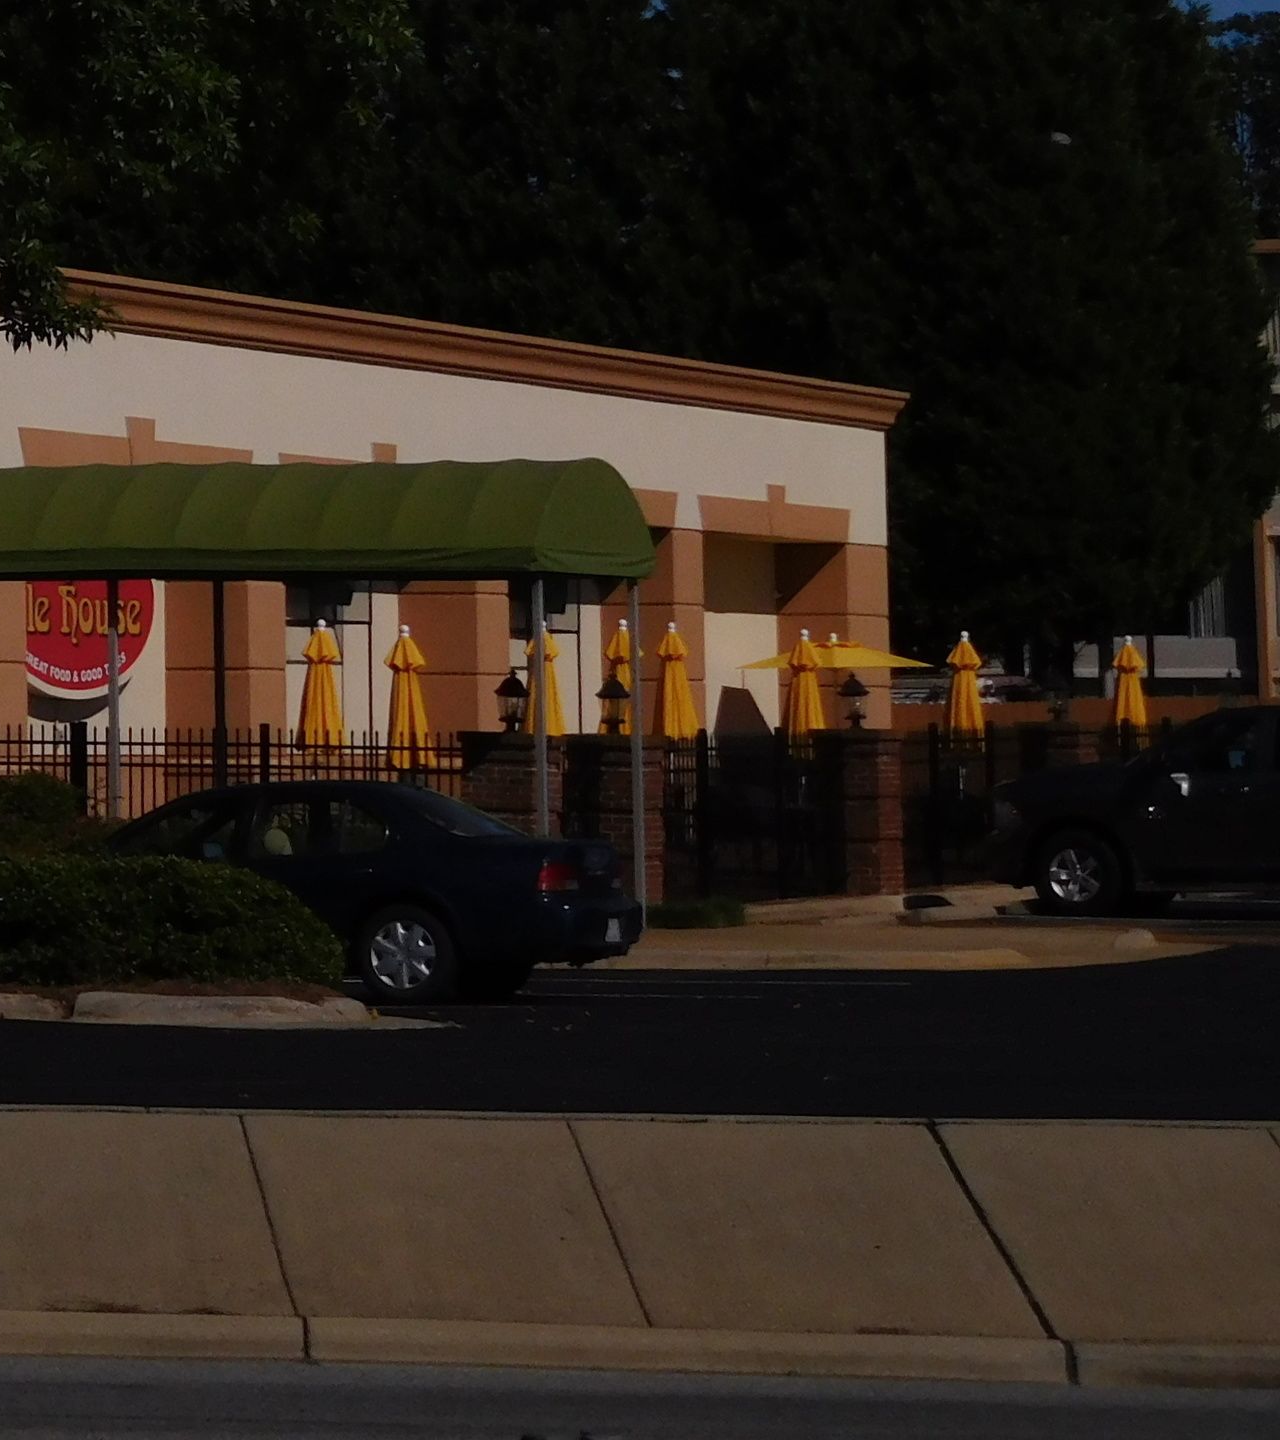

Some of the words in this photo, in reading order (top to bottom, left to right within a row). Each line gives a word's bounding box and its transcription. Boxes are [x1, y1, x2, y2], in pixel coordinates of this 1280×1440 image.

[49, 665, 72, 682] FOOD
[72, 670, 80, 683] &
[80, 666, 103, 682] GOOD
